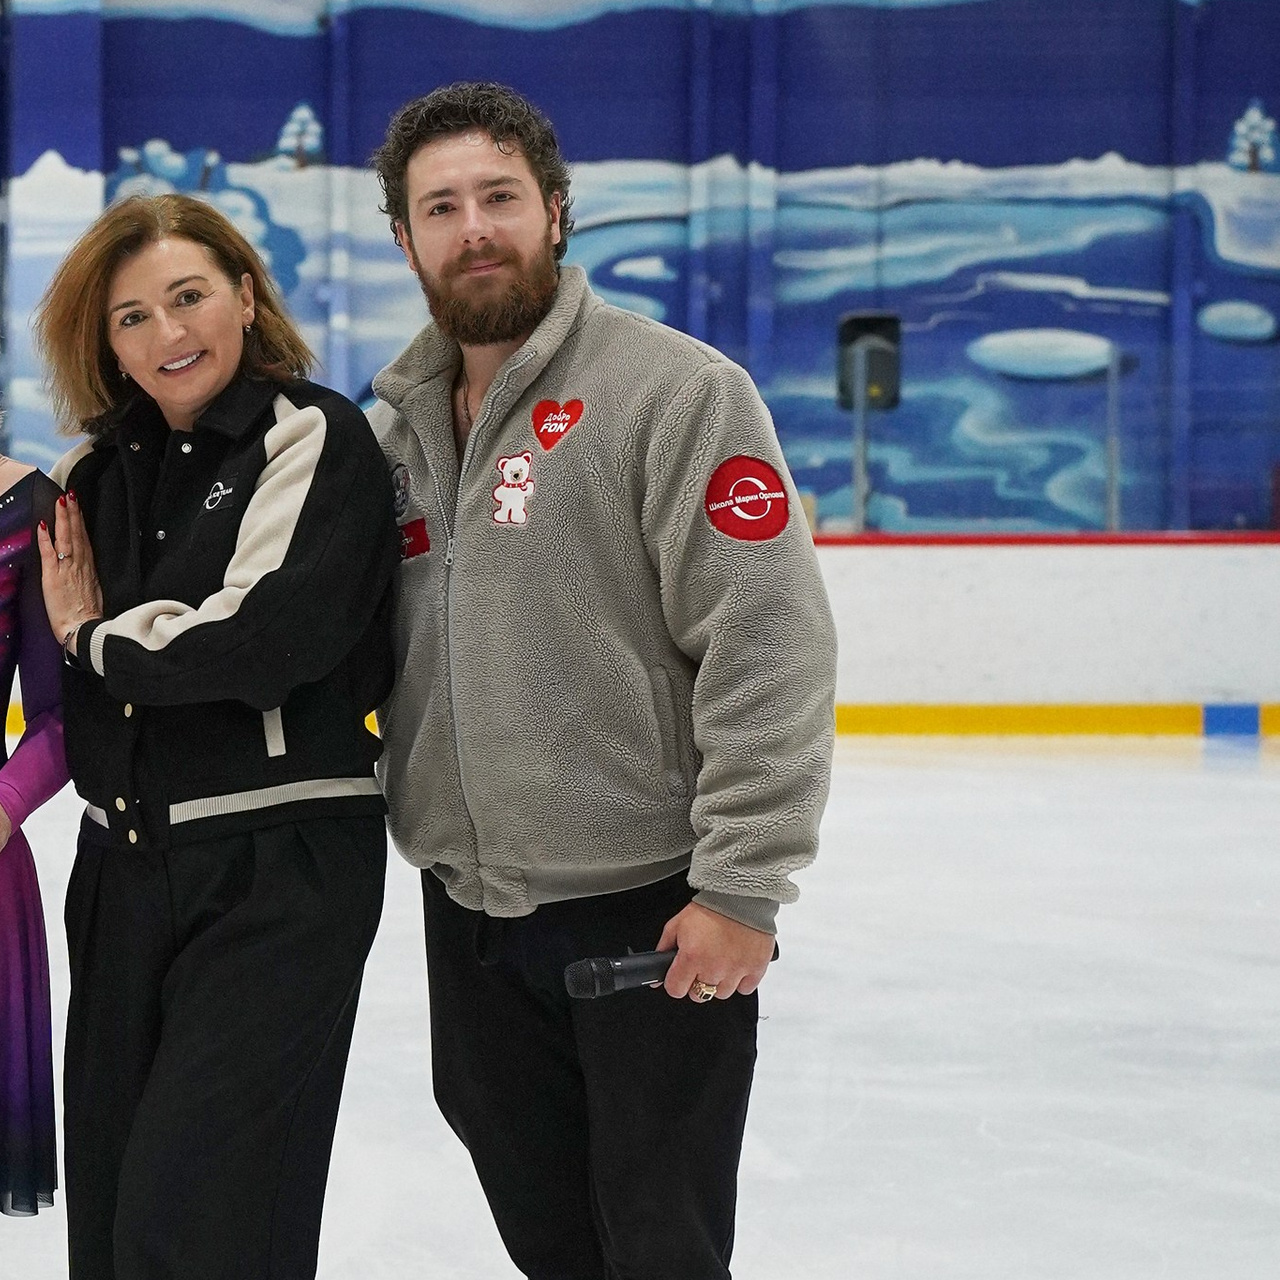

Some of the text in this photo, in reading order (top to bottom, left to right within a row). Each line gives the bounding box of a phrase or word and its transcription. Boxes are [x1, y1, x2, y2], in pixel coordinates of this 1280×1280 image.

[544, 409, 570, 422] Добро
[540, 422, 568, 433] FON
[709, 499, 734, 511] Школа
[734, 493, 758, 503] Марии
